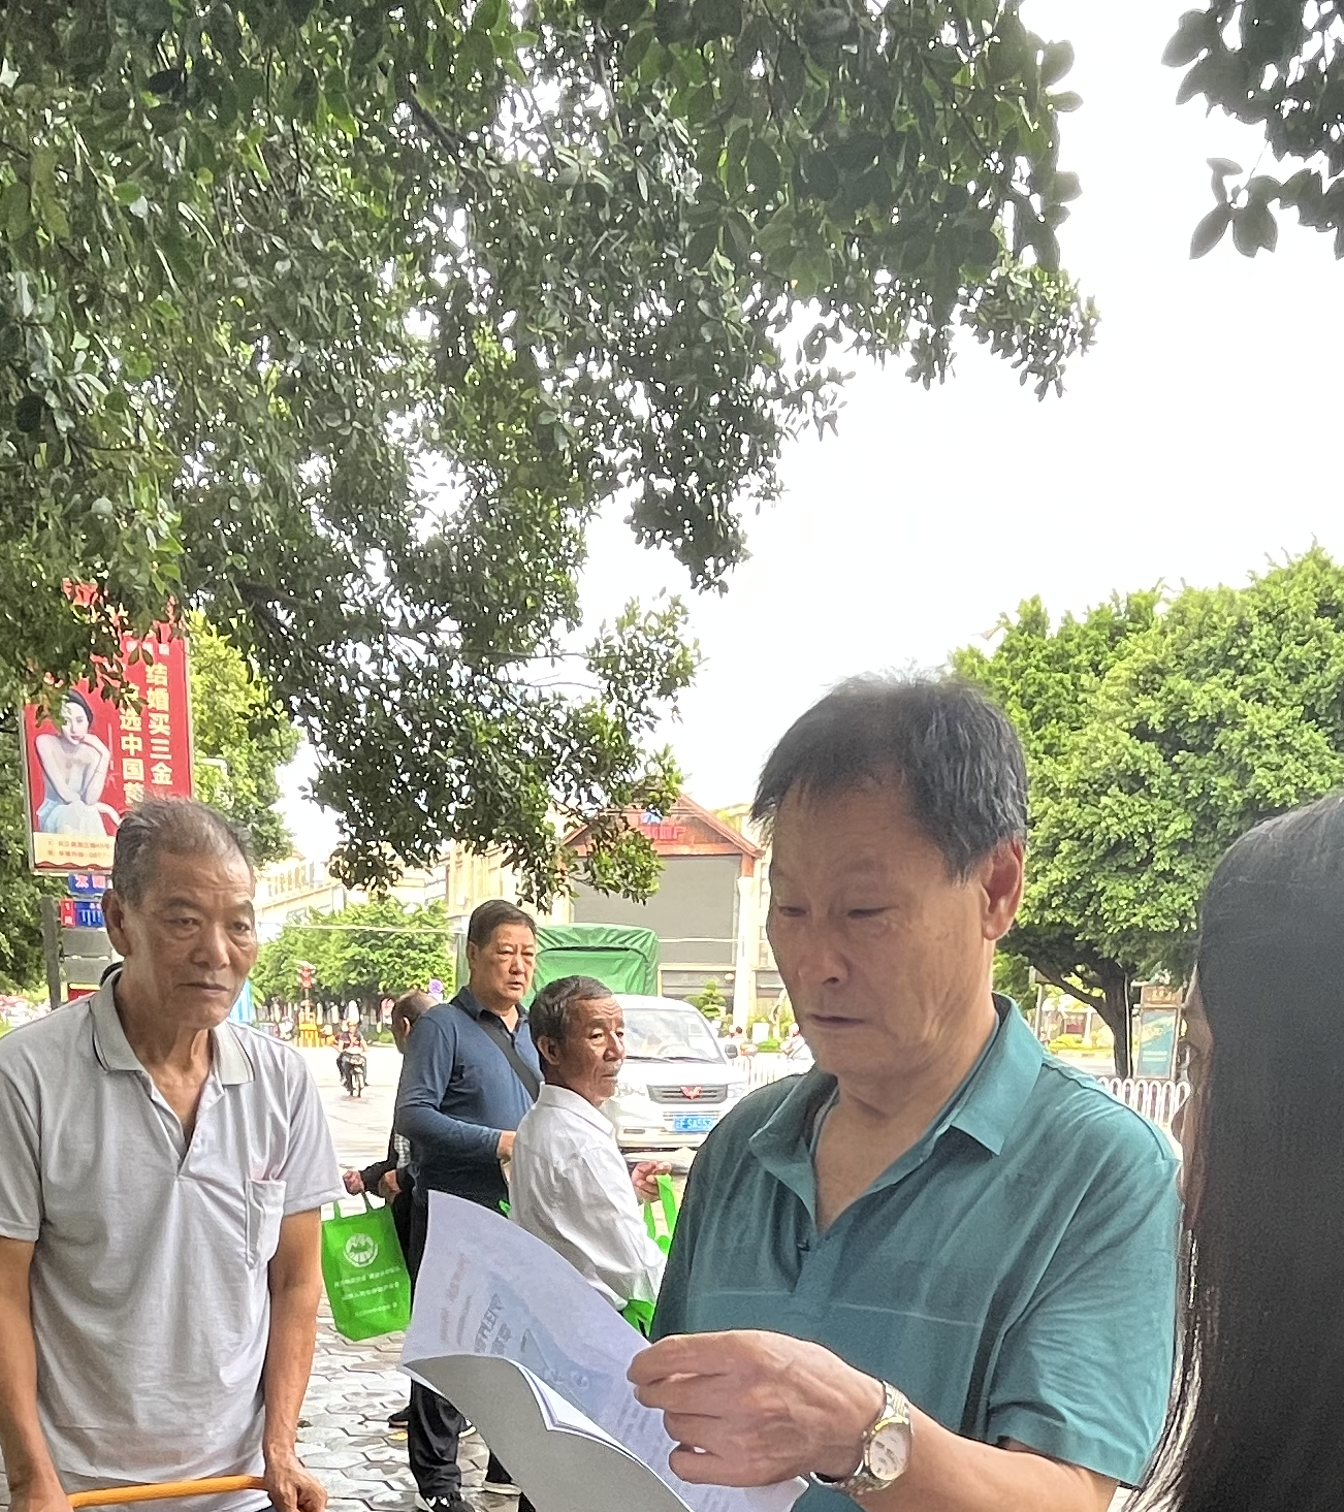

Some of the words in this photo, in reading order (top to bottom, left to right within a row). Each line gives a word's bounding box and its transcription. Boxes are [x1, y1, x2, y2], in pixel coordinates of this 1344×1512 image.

[145, 662, 173, 786] 结婚买三金
